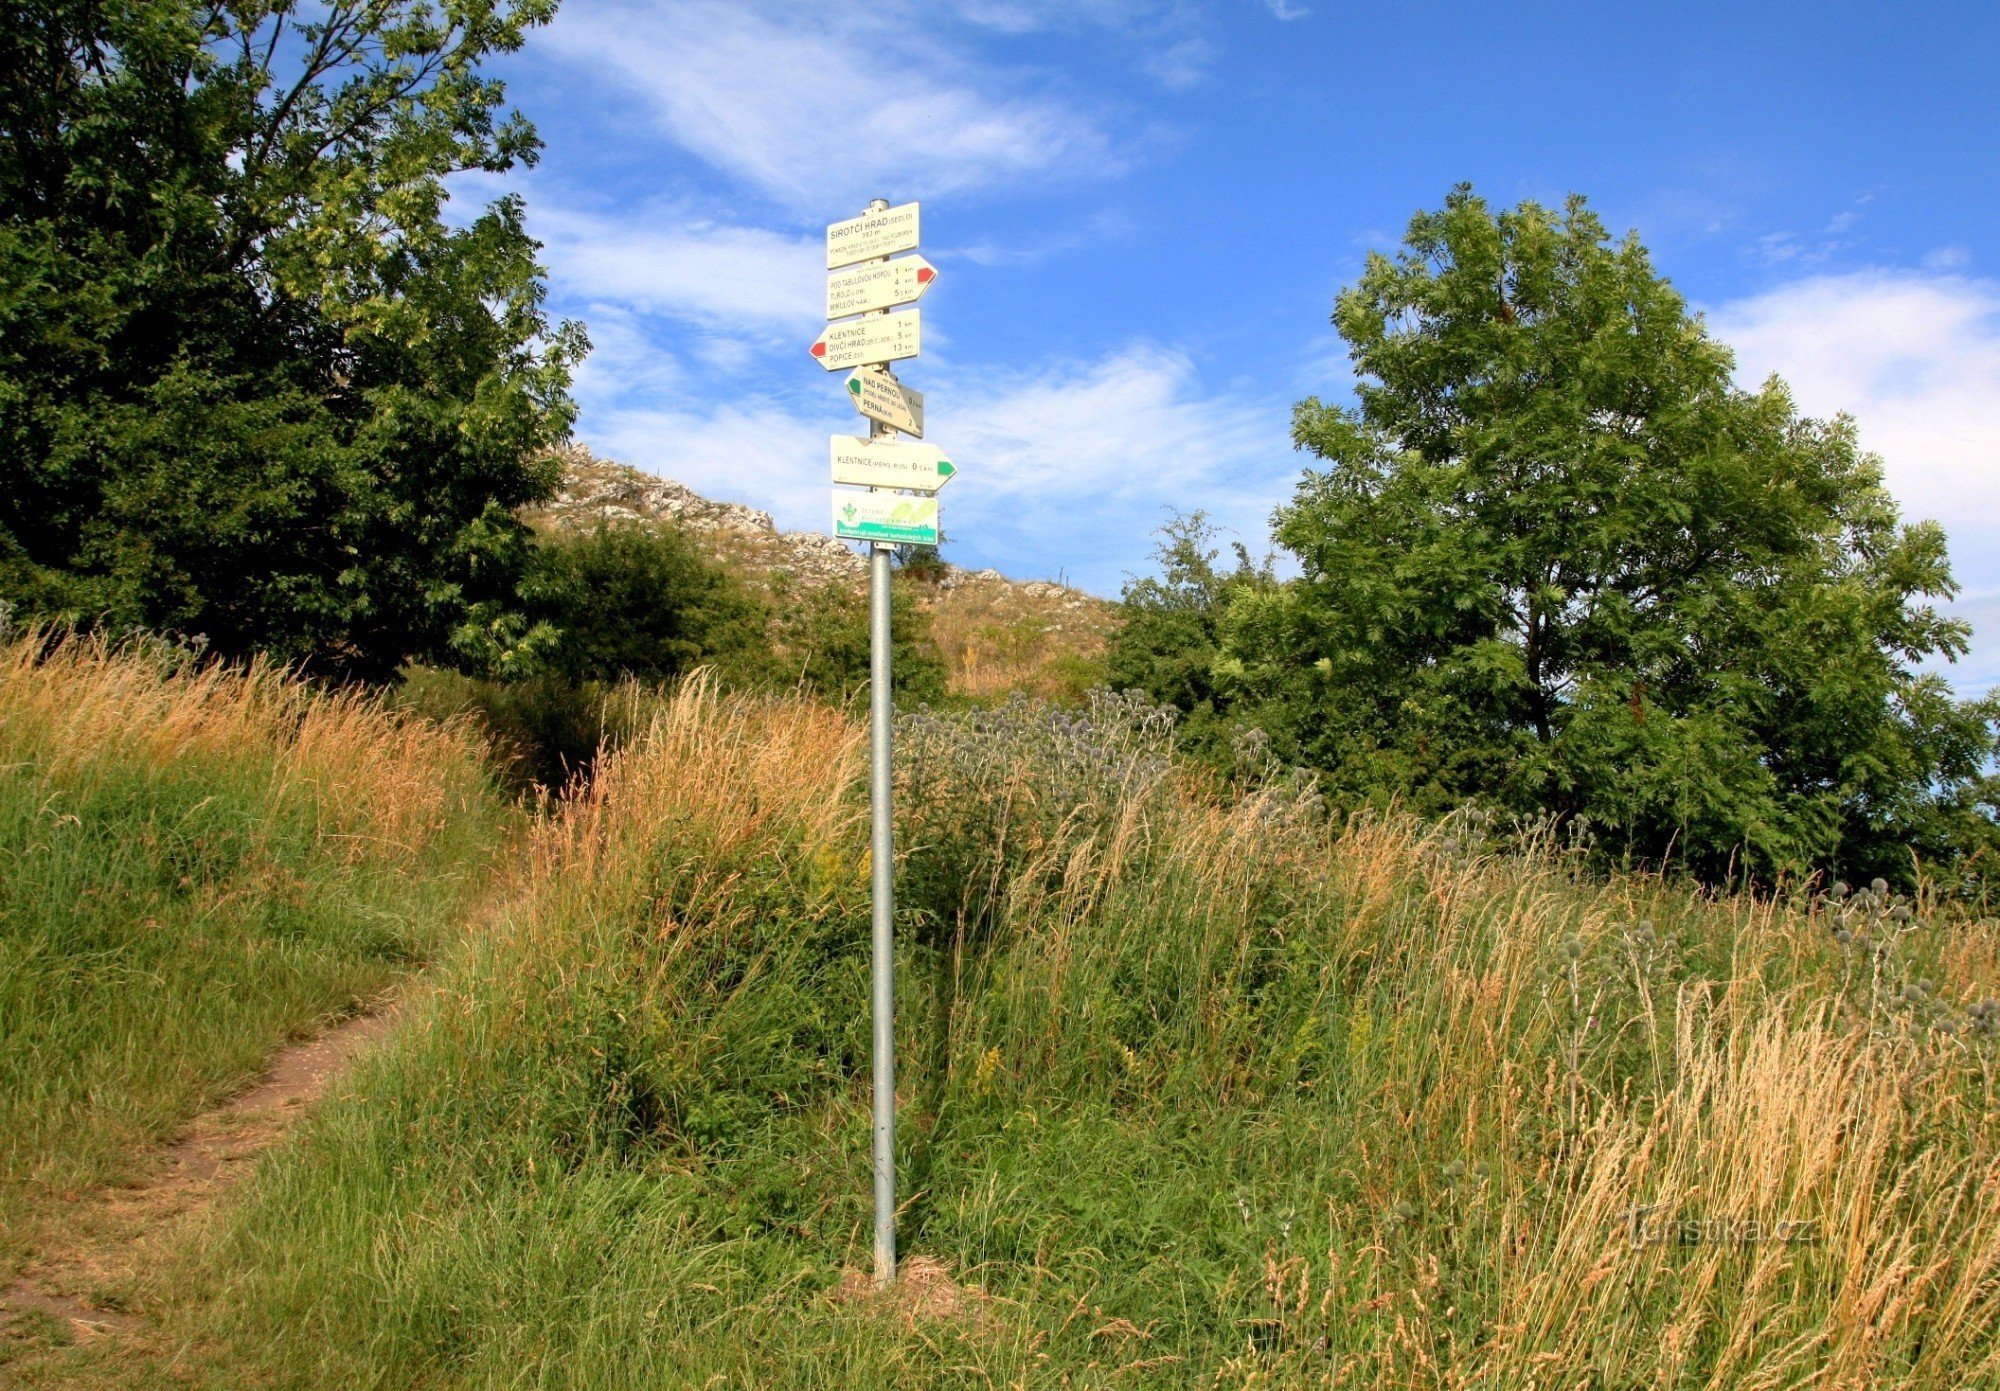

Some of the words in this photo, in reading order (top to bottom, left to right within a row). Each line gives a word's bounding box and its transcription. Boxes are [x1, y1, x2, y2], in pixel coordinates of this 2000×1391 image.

[830, 222, 863, 240] SIROTČÍ
[865, 217, 888, 231] HRAD
[889, 213, 913, 225] (SEDLO)
[830, 300, 855, 311] MIKULOV
[830, 327, 866, 340] KLENTNICE
[847, 338, 866, 349] HRAD
[897, 332, 903, 340] 5
[830, 351, 852, 362] POPICE
[893, 343, 903, 351] 13
[863, 376, 876, 388] NAD
[876, 382, 900, 399] PERNOU
[863, 398, 883, 413] PERNÁ
[908, 418, 913, 427] 2
[837, 455, 872, 467] KLENTNICE
